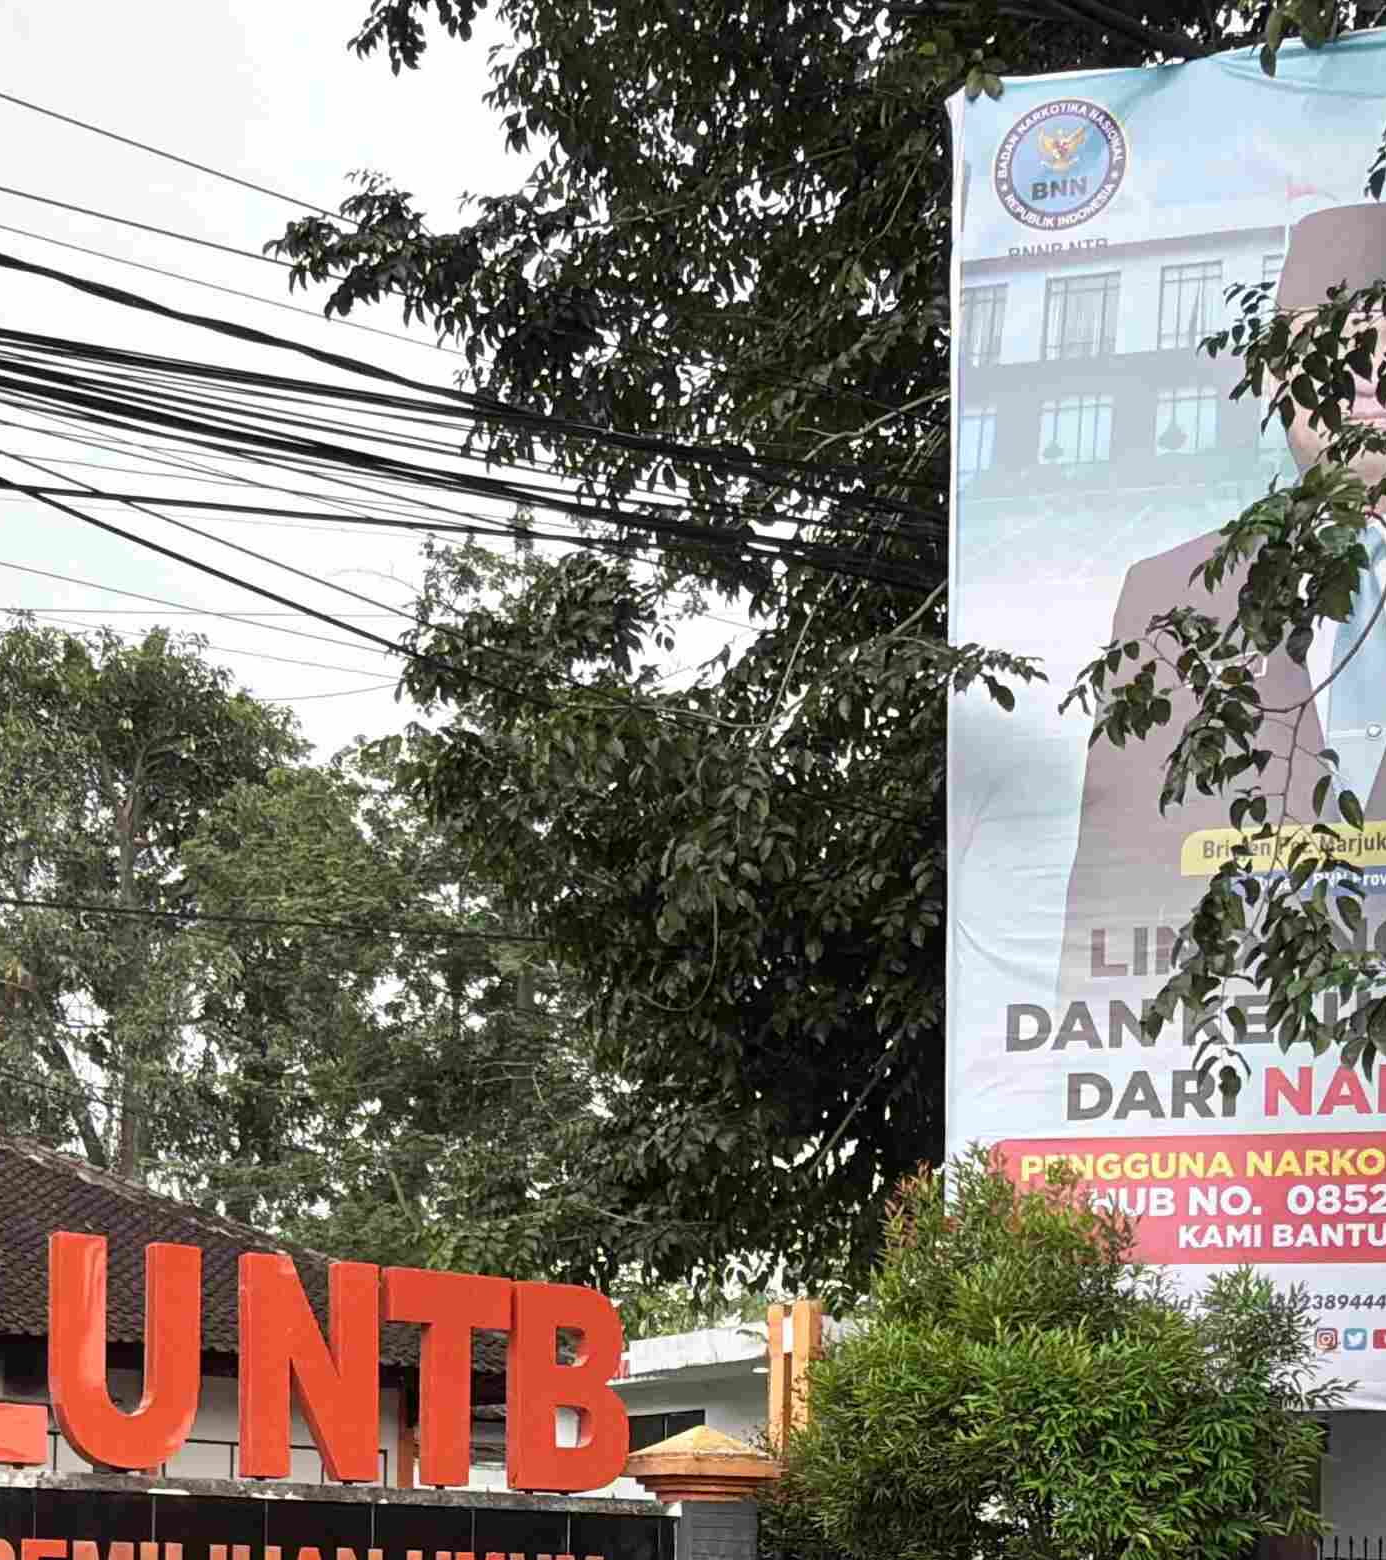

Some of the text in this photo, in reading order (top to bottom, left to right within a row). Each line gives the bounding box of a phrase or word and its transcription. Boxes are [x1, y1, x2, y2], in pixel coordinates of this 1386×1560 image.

[1031, 176, 1088, 201] BNN
[1006, 1000, 1157, 1053] DAN
[1090, 1186, 1175, 1217] HUB
[1188, 1185, 1262, 1216] NO.
[1178, 1224, 1262, 1249] KAMI
[238, 1252, 629, 1491] NTB
